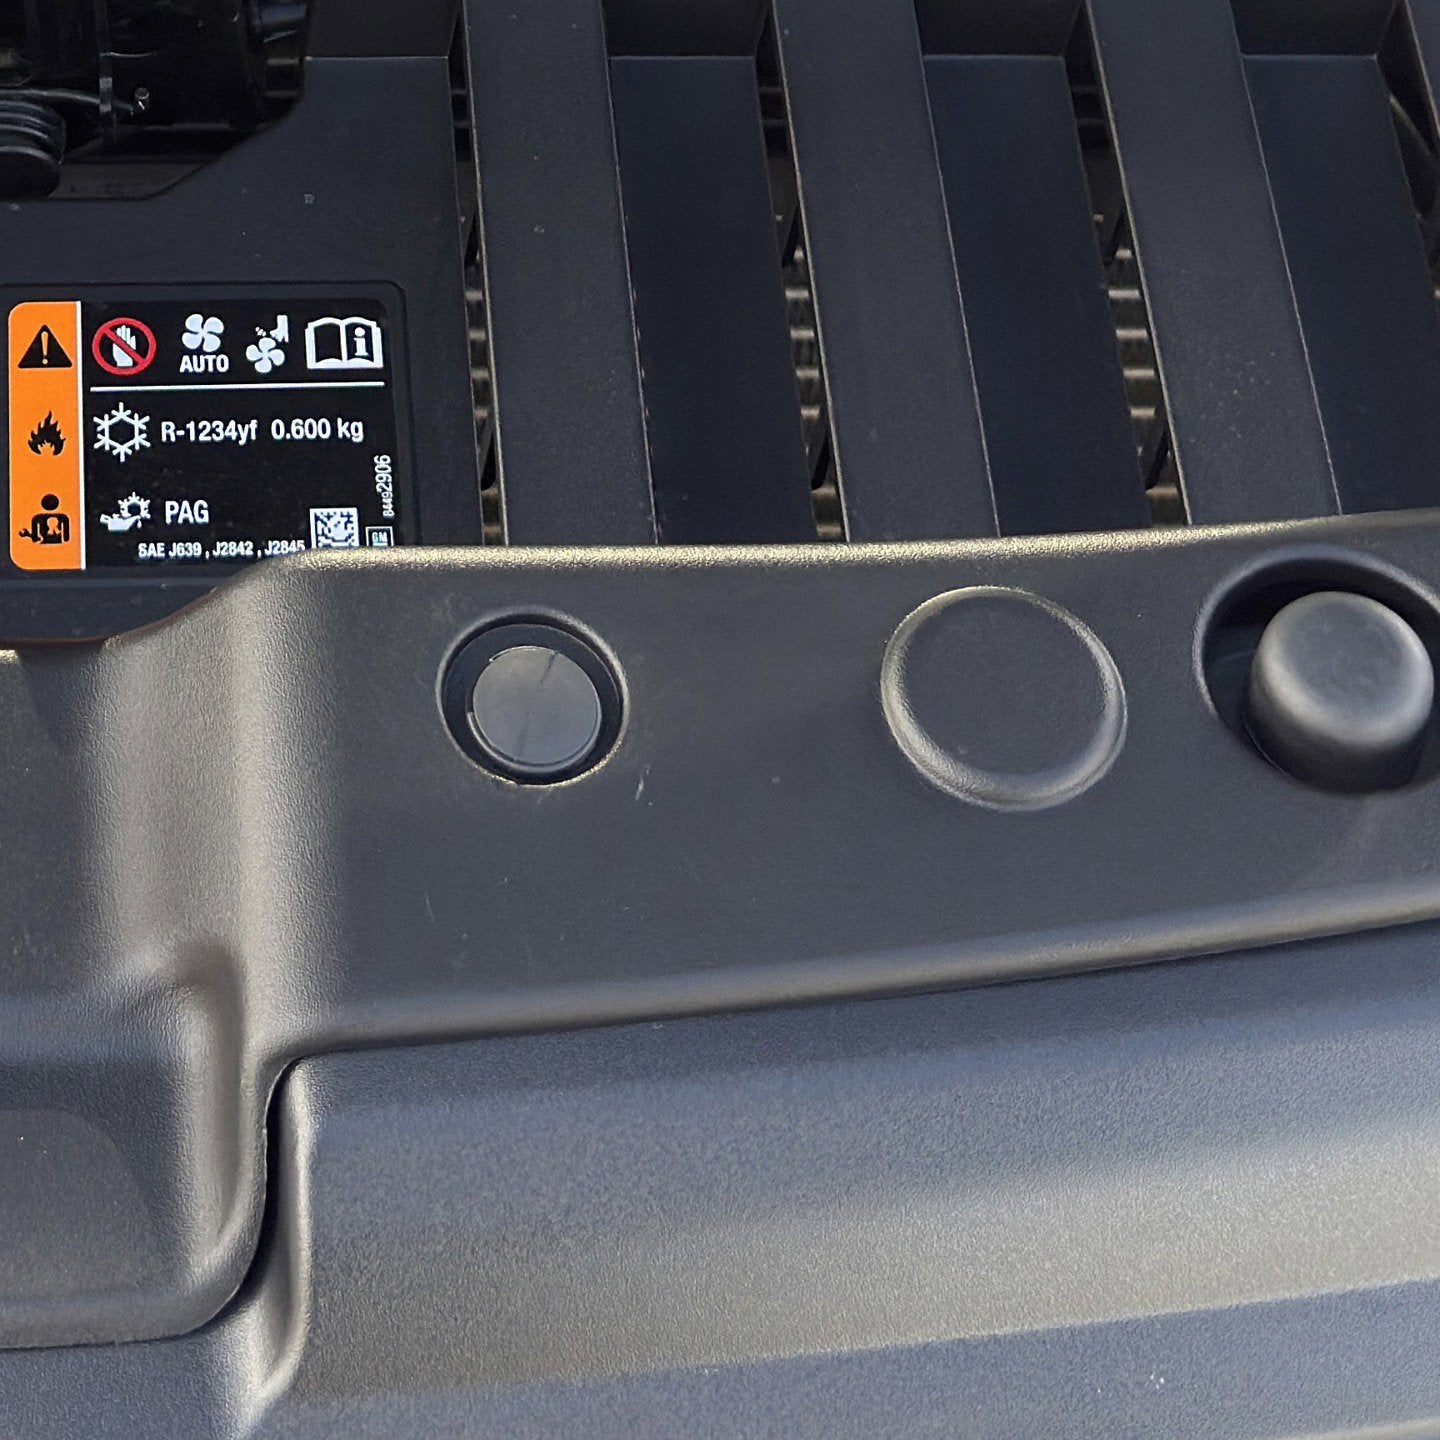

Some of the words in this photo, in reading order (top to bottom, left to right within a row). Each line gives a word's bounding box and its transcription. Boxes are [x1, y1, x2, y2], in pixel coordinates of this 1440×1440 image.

[179, 353, 230, 373] AUTO
[160, 419, 258, 445] R-1234yf
[270, 417, 332, 440] 0.600
[336, 417, 364, 444] kg
[164, 499, 210, 524] PAG
[137, 542, 166, 558] SAE
